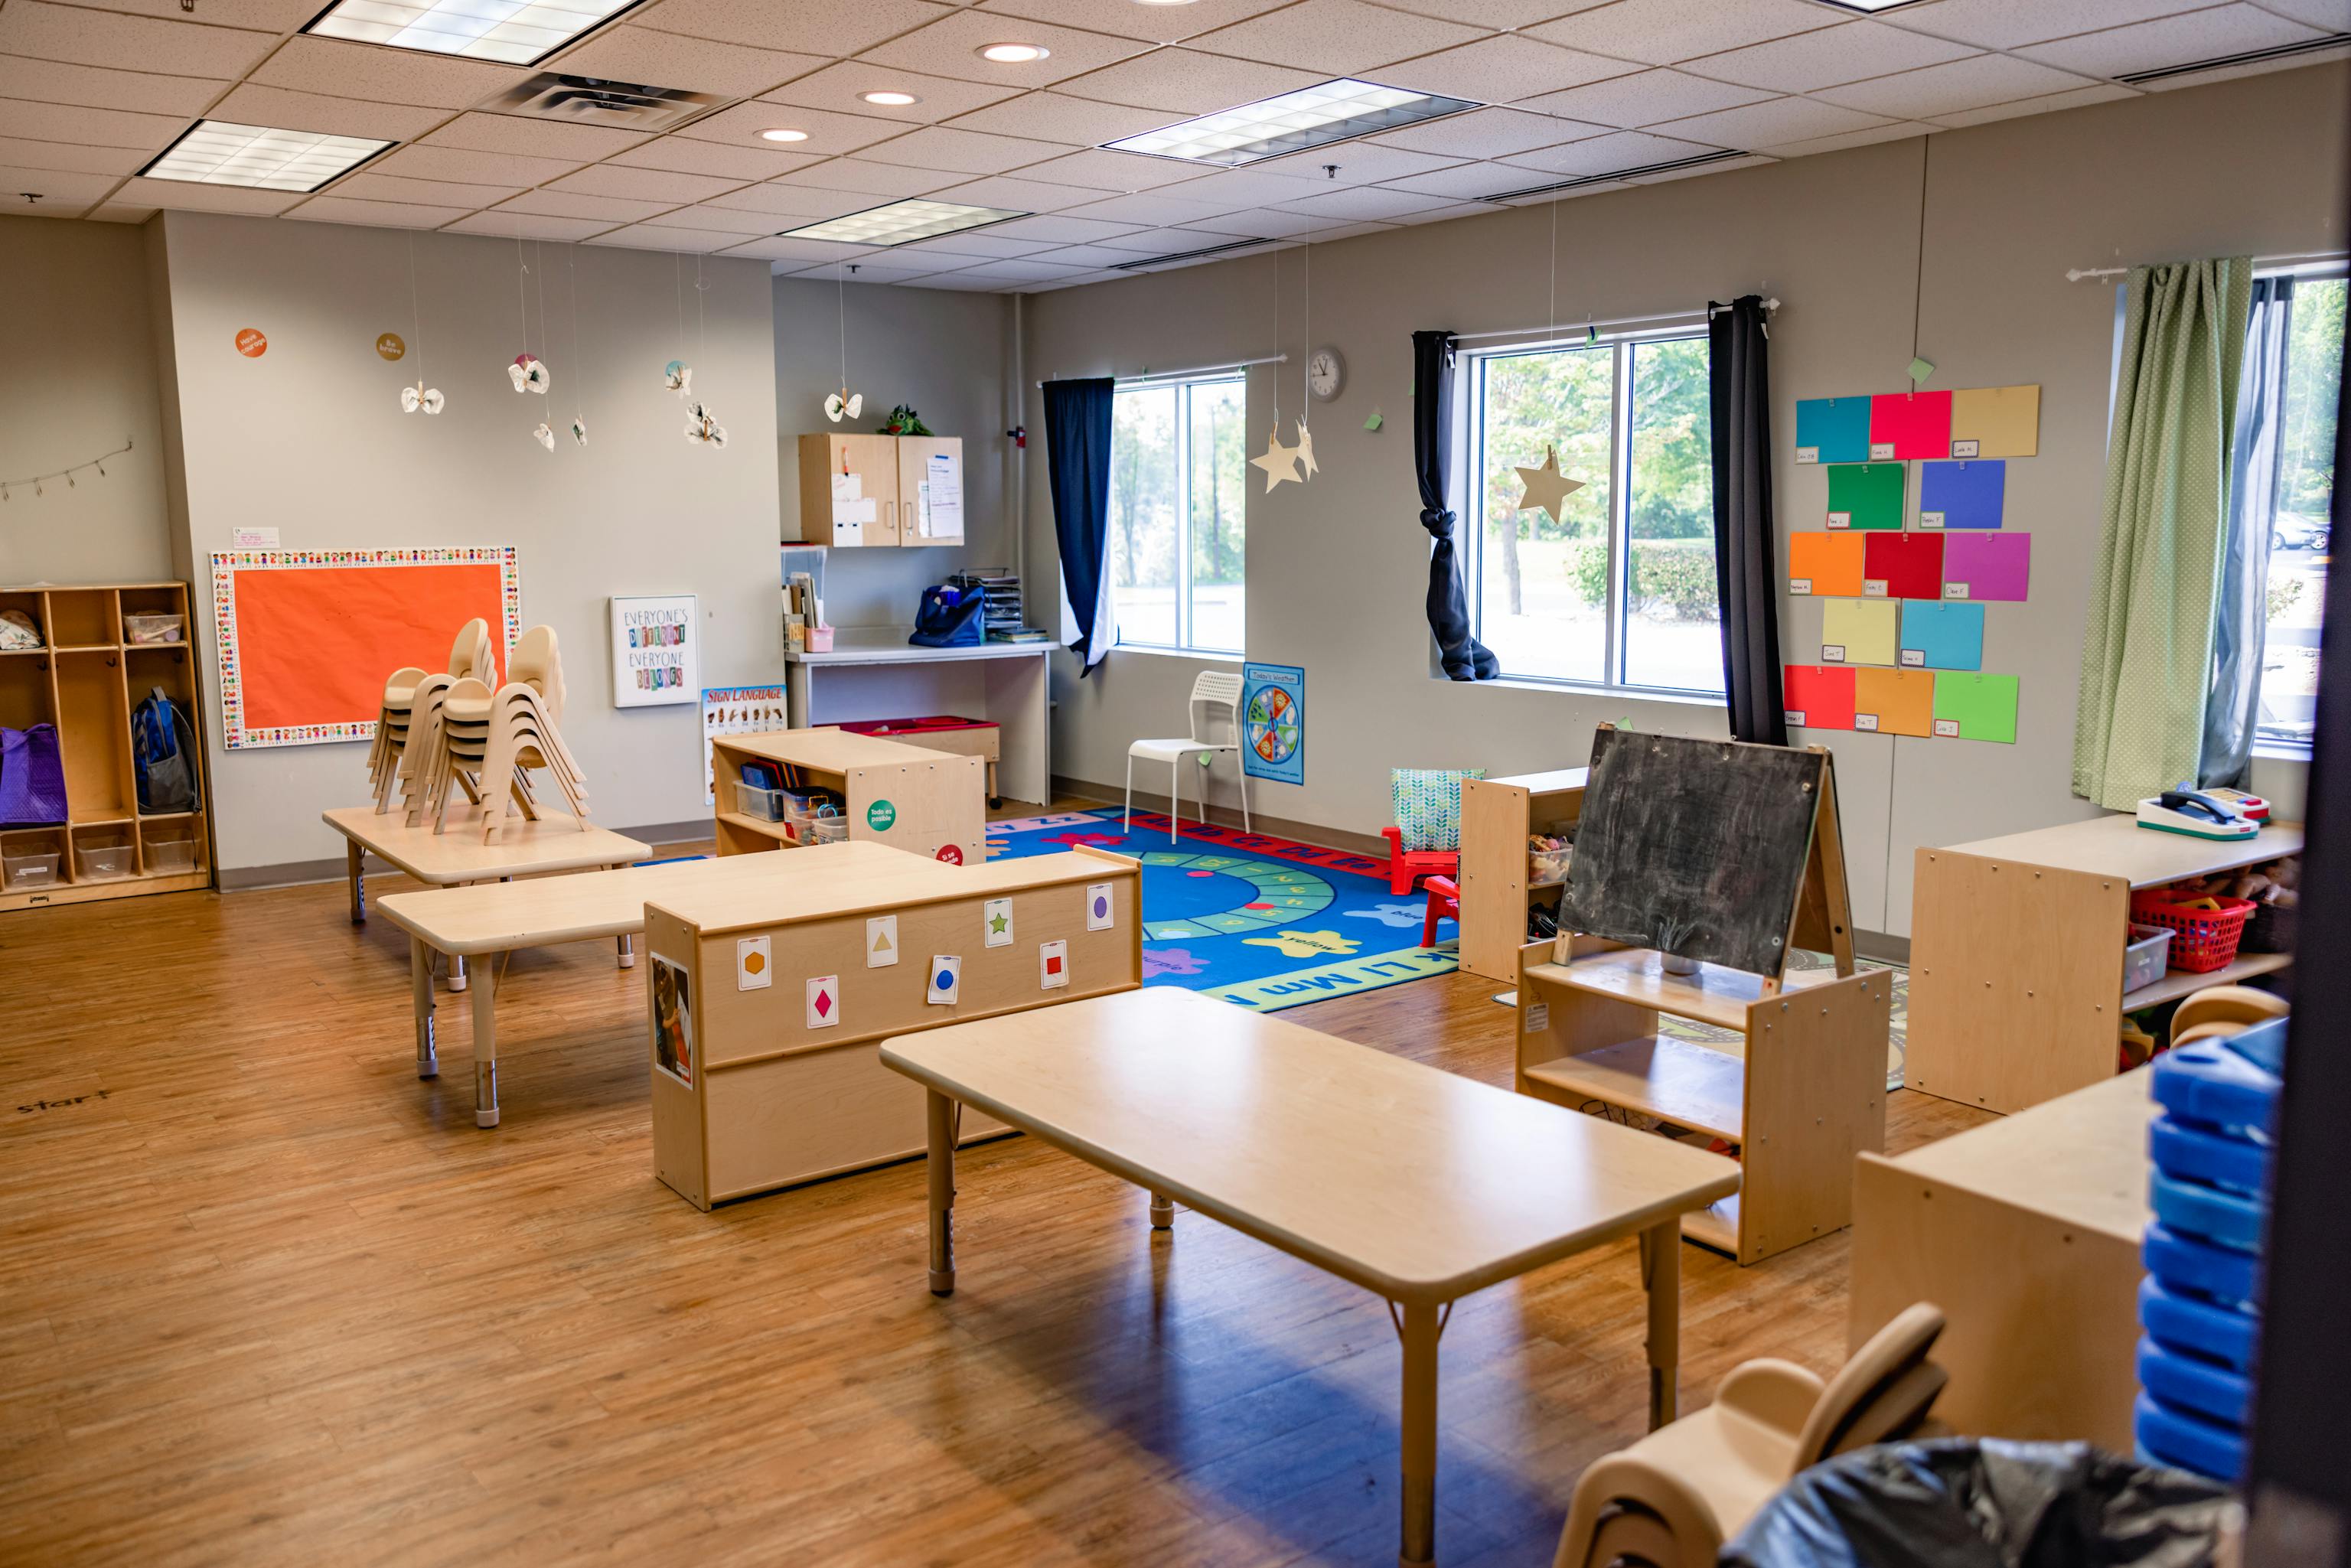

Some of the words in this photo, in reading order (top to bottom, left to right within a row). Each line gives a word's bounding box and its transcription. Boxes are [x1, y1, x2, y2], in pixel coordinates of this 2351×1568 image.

[240, 334, 257, 346] Have
[241, 337, 266, 354] courage
[386, 339, 396, 347] Be
[380, 344, 402, 354] brave
[624, 608, 688, 626] EVERYONE'S
[629, 624, 685, 647] DIFFERENT
[629, 651, 685, 667] EVERYONE
[636, 667, 683, 691] BELONGS
[707, 690, 730, 703] SIGN
[732, 688, 782, 702] LANGUAGE
[871, 815, 891, 823] posible
[1182, 826, 1225, 837] Bb
[1232, 836, 1273, 847] Cc
[1276, 846, 1333, 859] Dd
[1329, 857, 1377, 869] Ee
[1199, 859, 1231, 868] 20
[1391, 910, 1423, 920] blue
[1285, 937, 1338, 950] yellow
[1257, 973, 1363, 995] Mm
